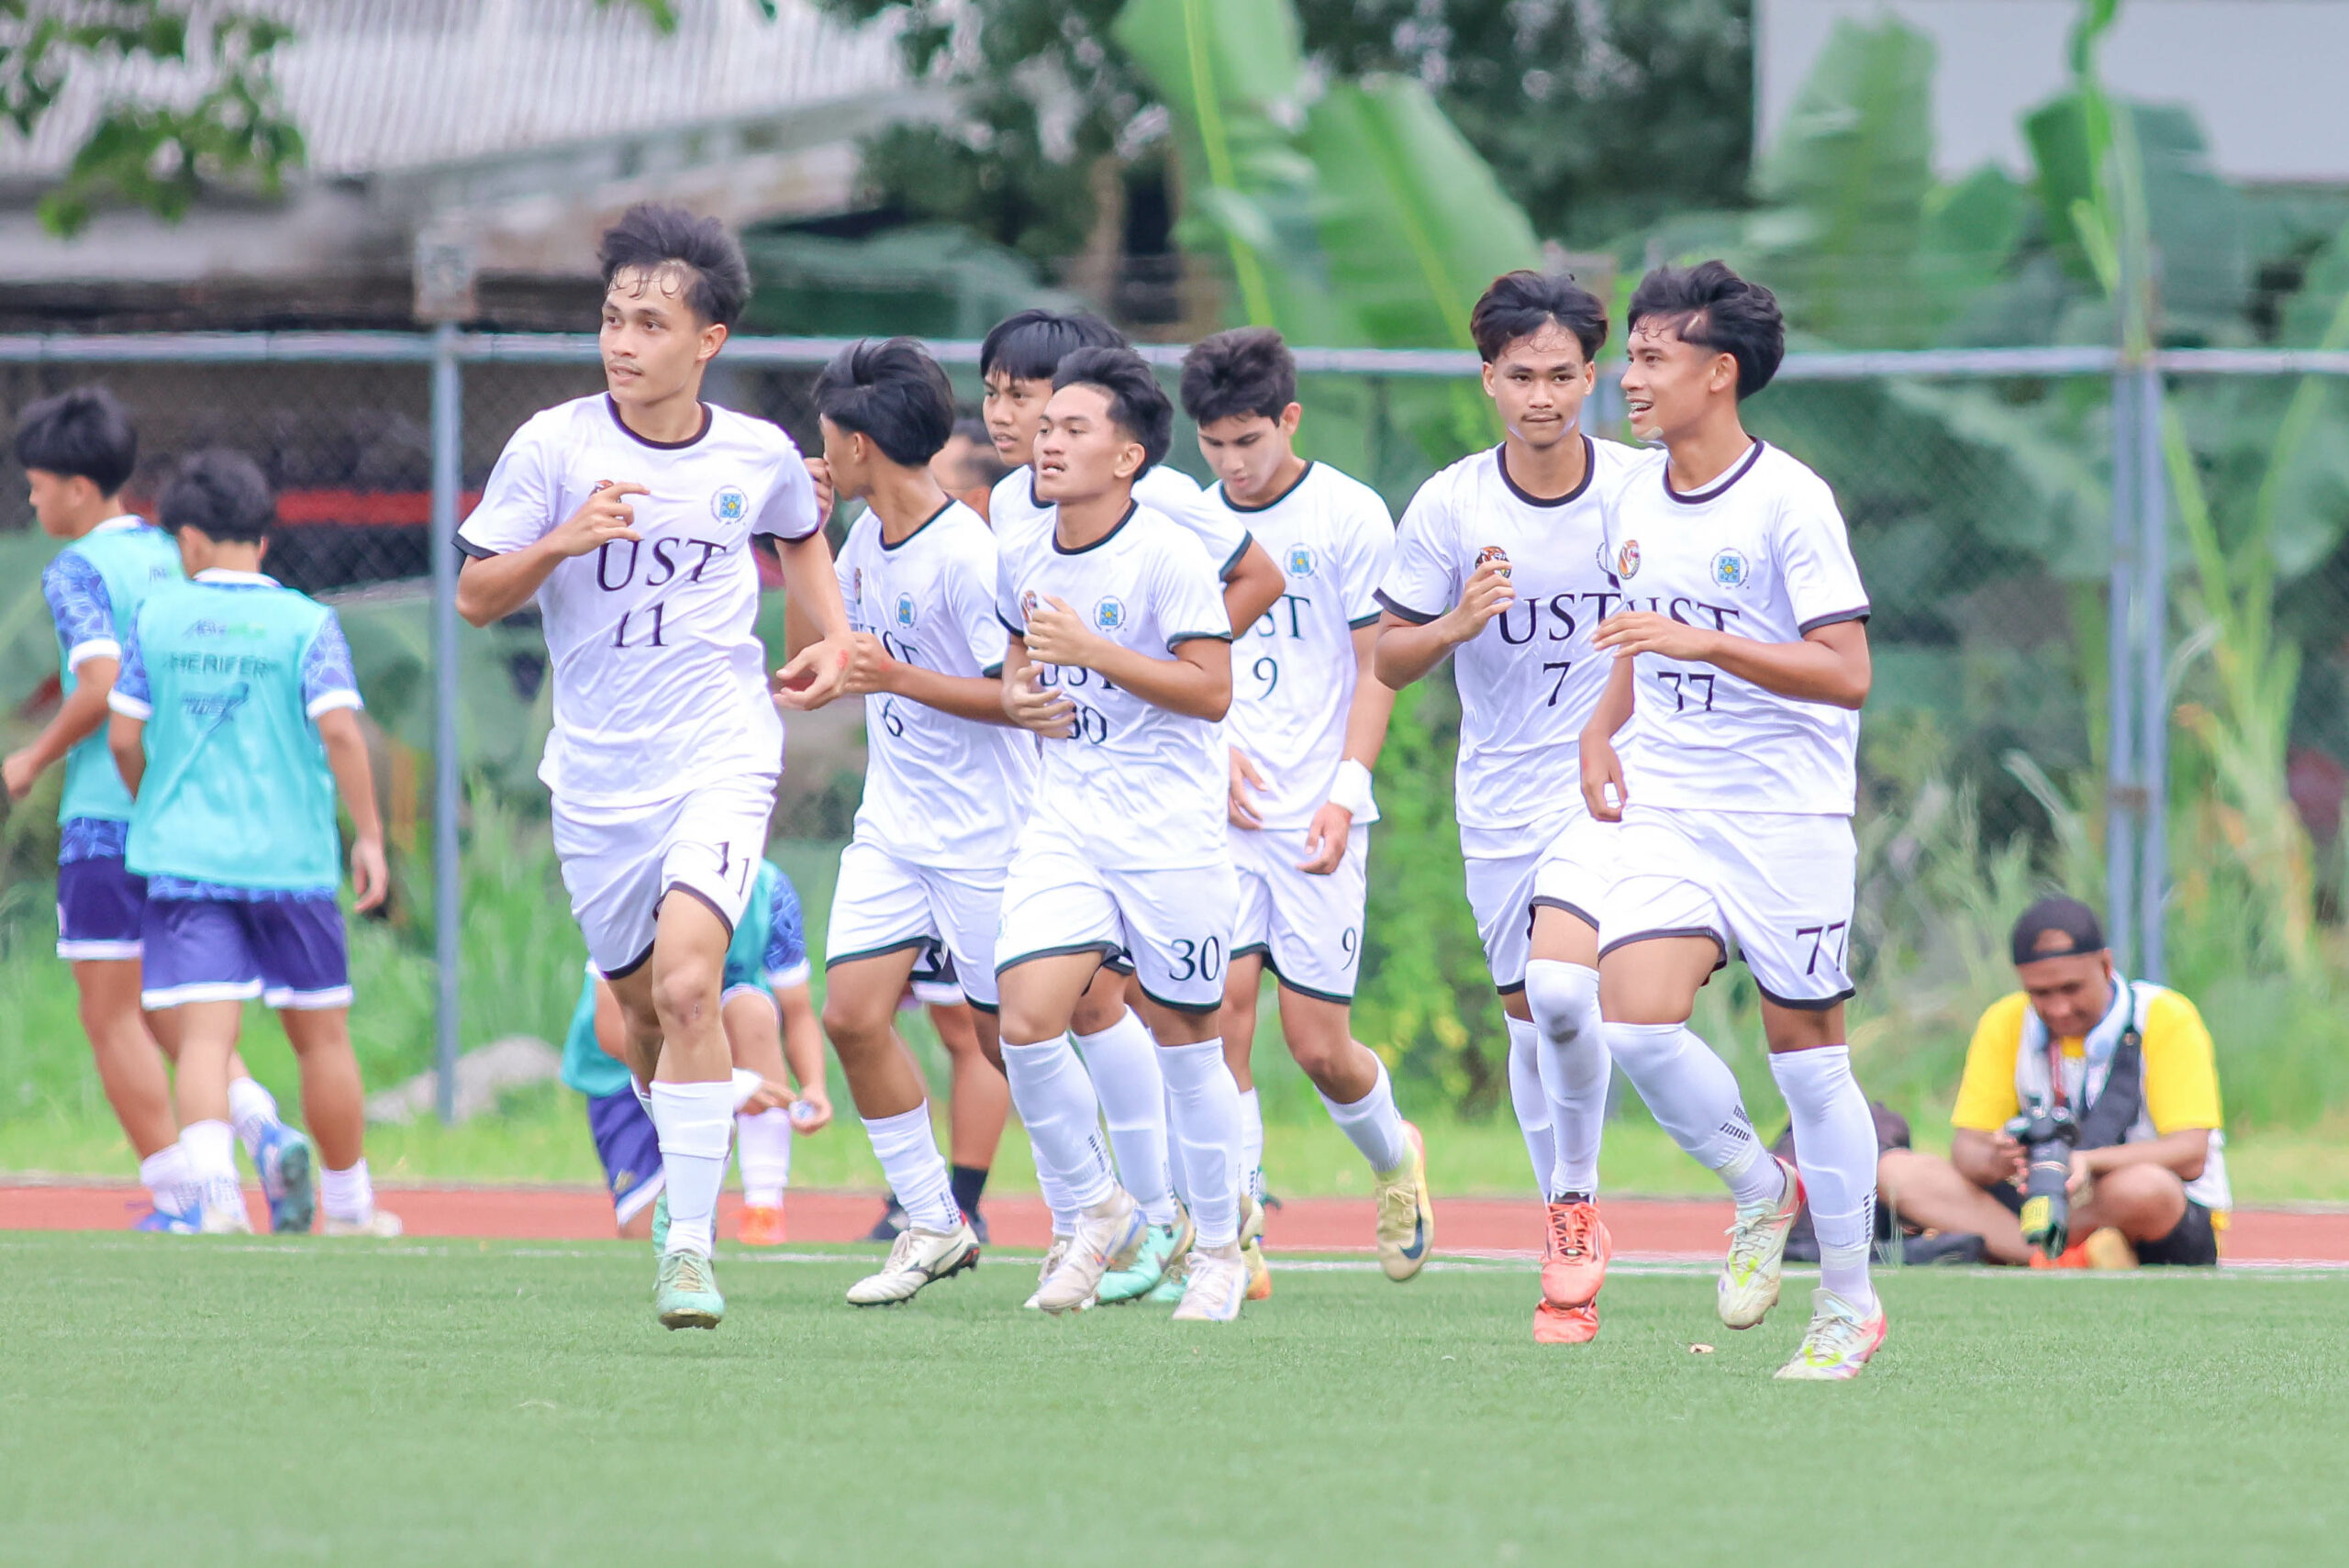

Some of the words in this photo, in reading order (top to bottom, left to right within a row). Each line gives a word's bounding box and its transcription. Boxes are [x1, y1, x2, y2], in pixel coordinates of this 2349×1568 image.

[596, 536, 728, 593] UST
[609, 600, 669, 648] 11
[1498, 592, 1622, 645] UST
[1252, 656, 1278, 701] 9
[1542, 661, 1572, 707] 7
[1657, 671, 1716, 713] 77
[881, 696, 904, 738] 6
[711, 840, 751, 903] 11
[1168, 935, 1220, 982] 30
[1341, 927, 1358, 971] 9
[1795, 919, 1846, 976] 77
